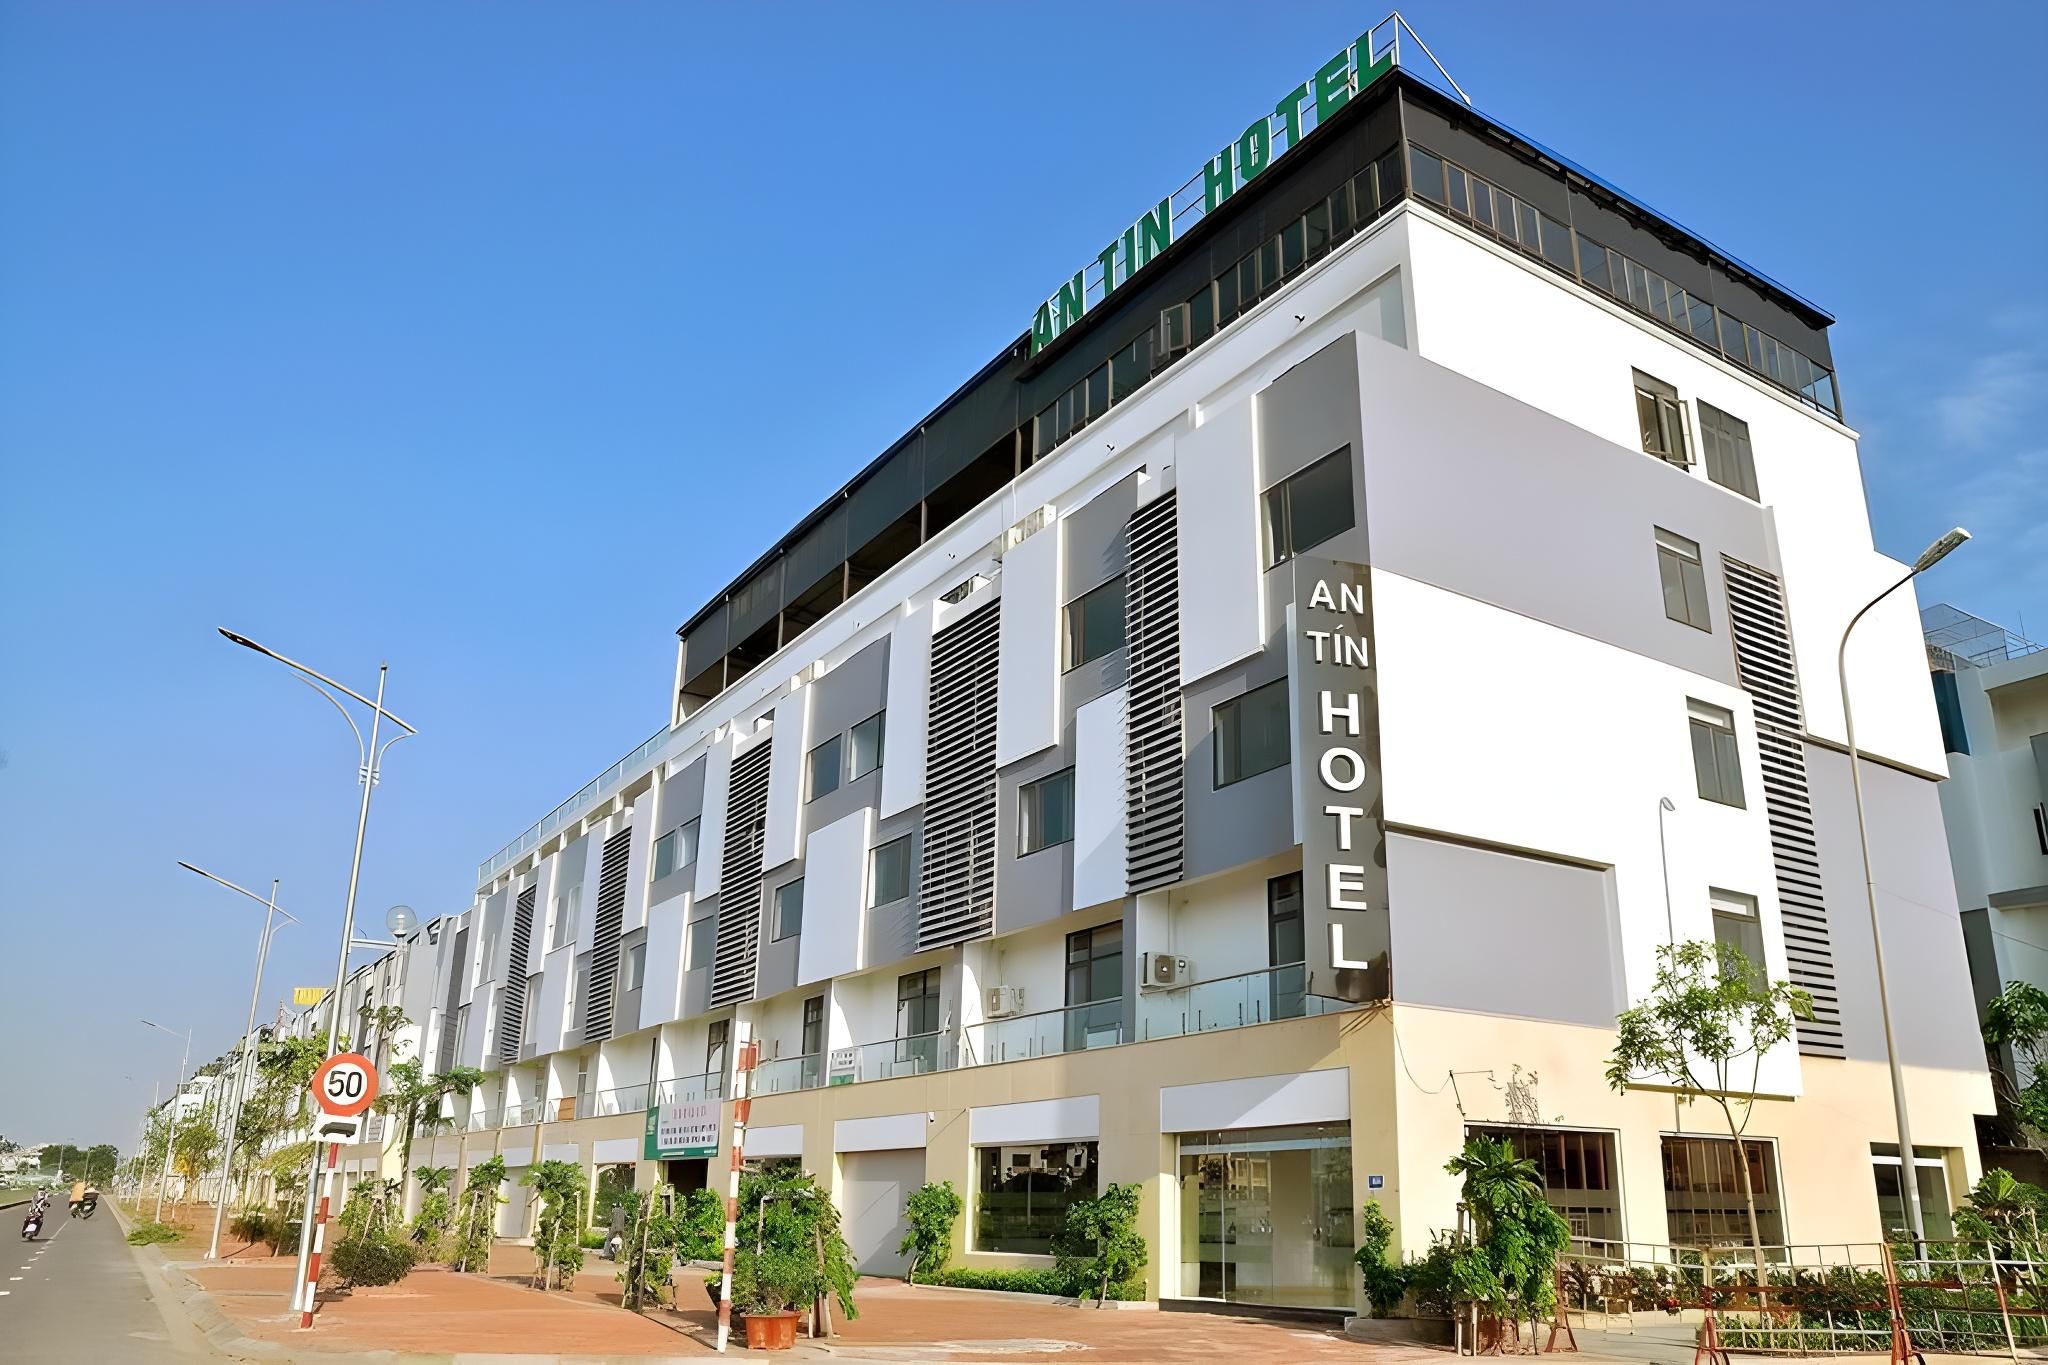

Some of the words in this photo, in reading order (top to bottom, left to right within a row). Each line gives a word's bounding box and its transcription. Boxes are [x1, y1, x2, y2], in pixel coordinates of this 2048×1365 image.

[1031, 270, 1087, 358] AN
[1204, 29, 1395, 214] HOTEL
[1308, 579, 1364, 615] AN
[1306, 624, 1369, 668] TÍN
[1319, 690, 1369, 970] HOTEL
[328, 1070, 362, 1098] 50
